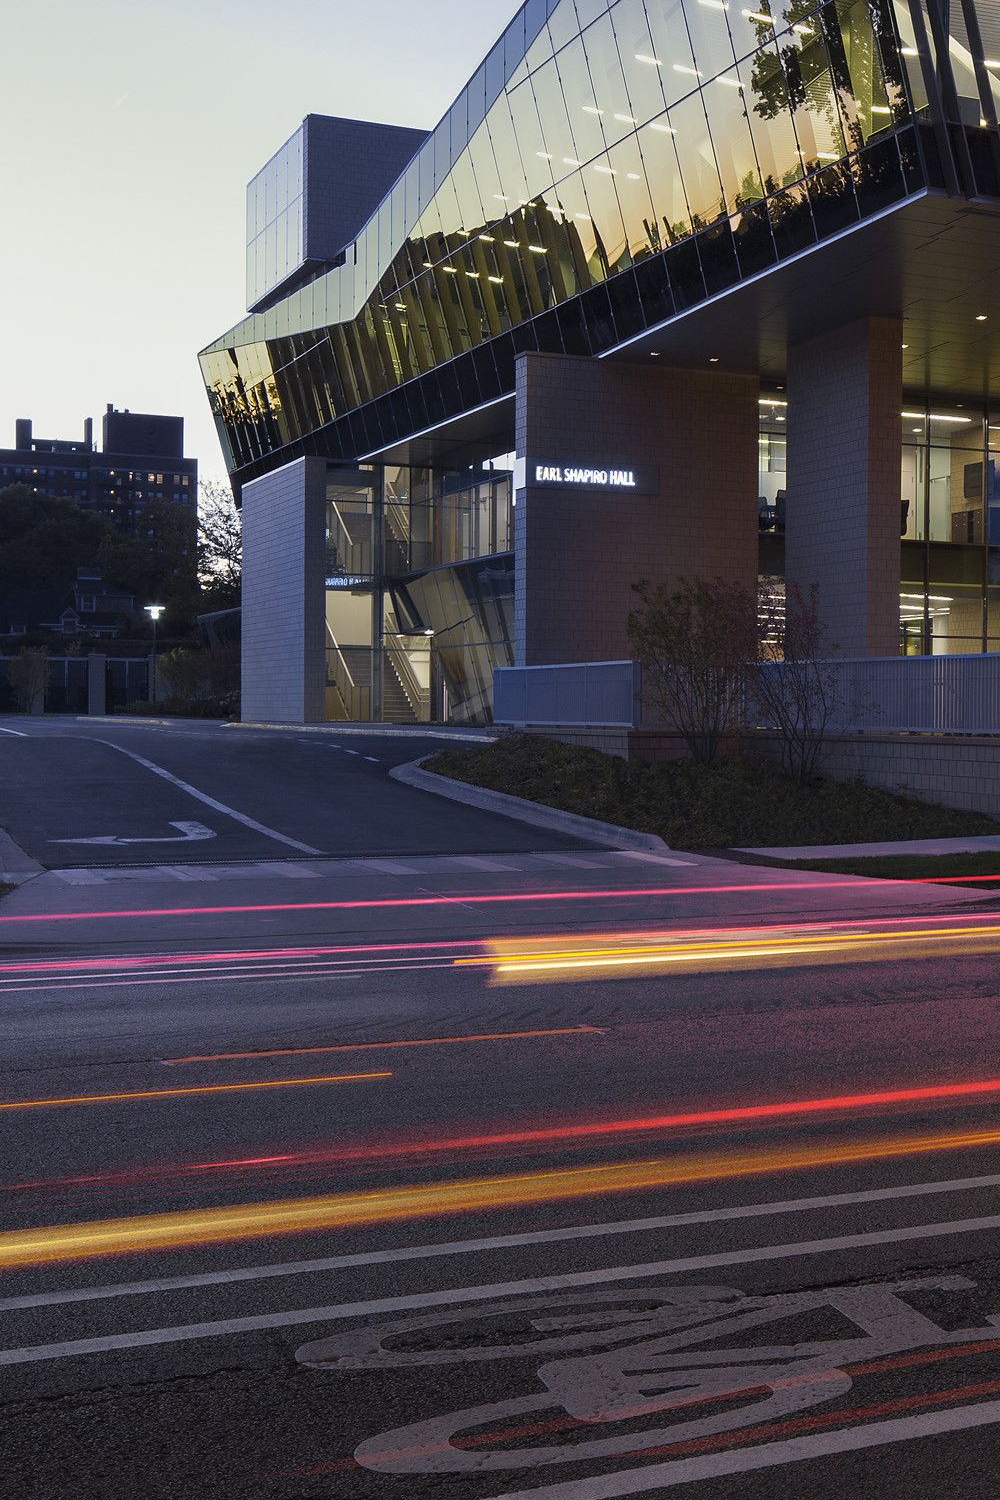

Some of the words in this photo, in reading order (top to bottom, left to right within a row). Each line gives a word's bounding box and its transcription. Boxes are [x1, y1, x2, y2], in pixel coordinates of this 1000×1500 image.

[536, 466, 562, 481] EARL
[564, 468, 607, 484] SHAPIRO
[609, 471, 636, 486] HALL
